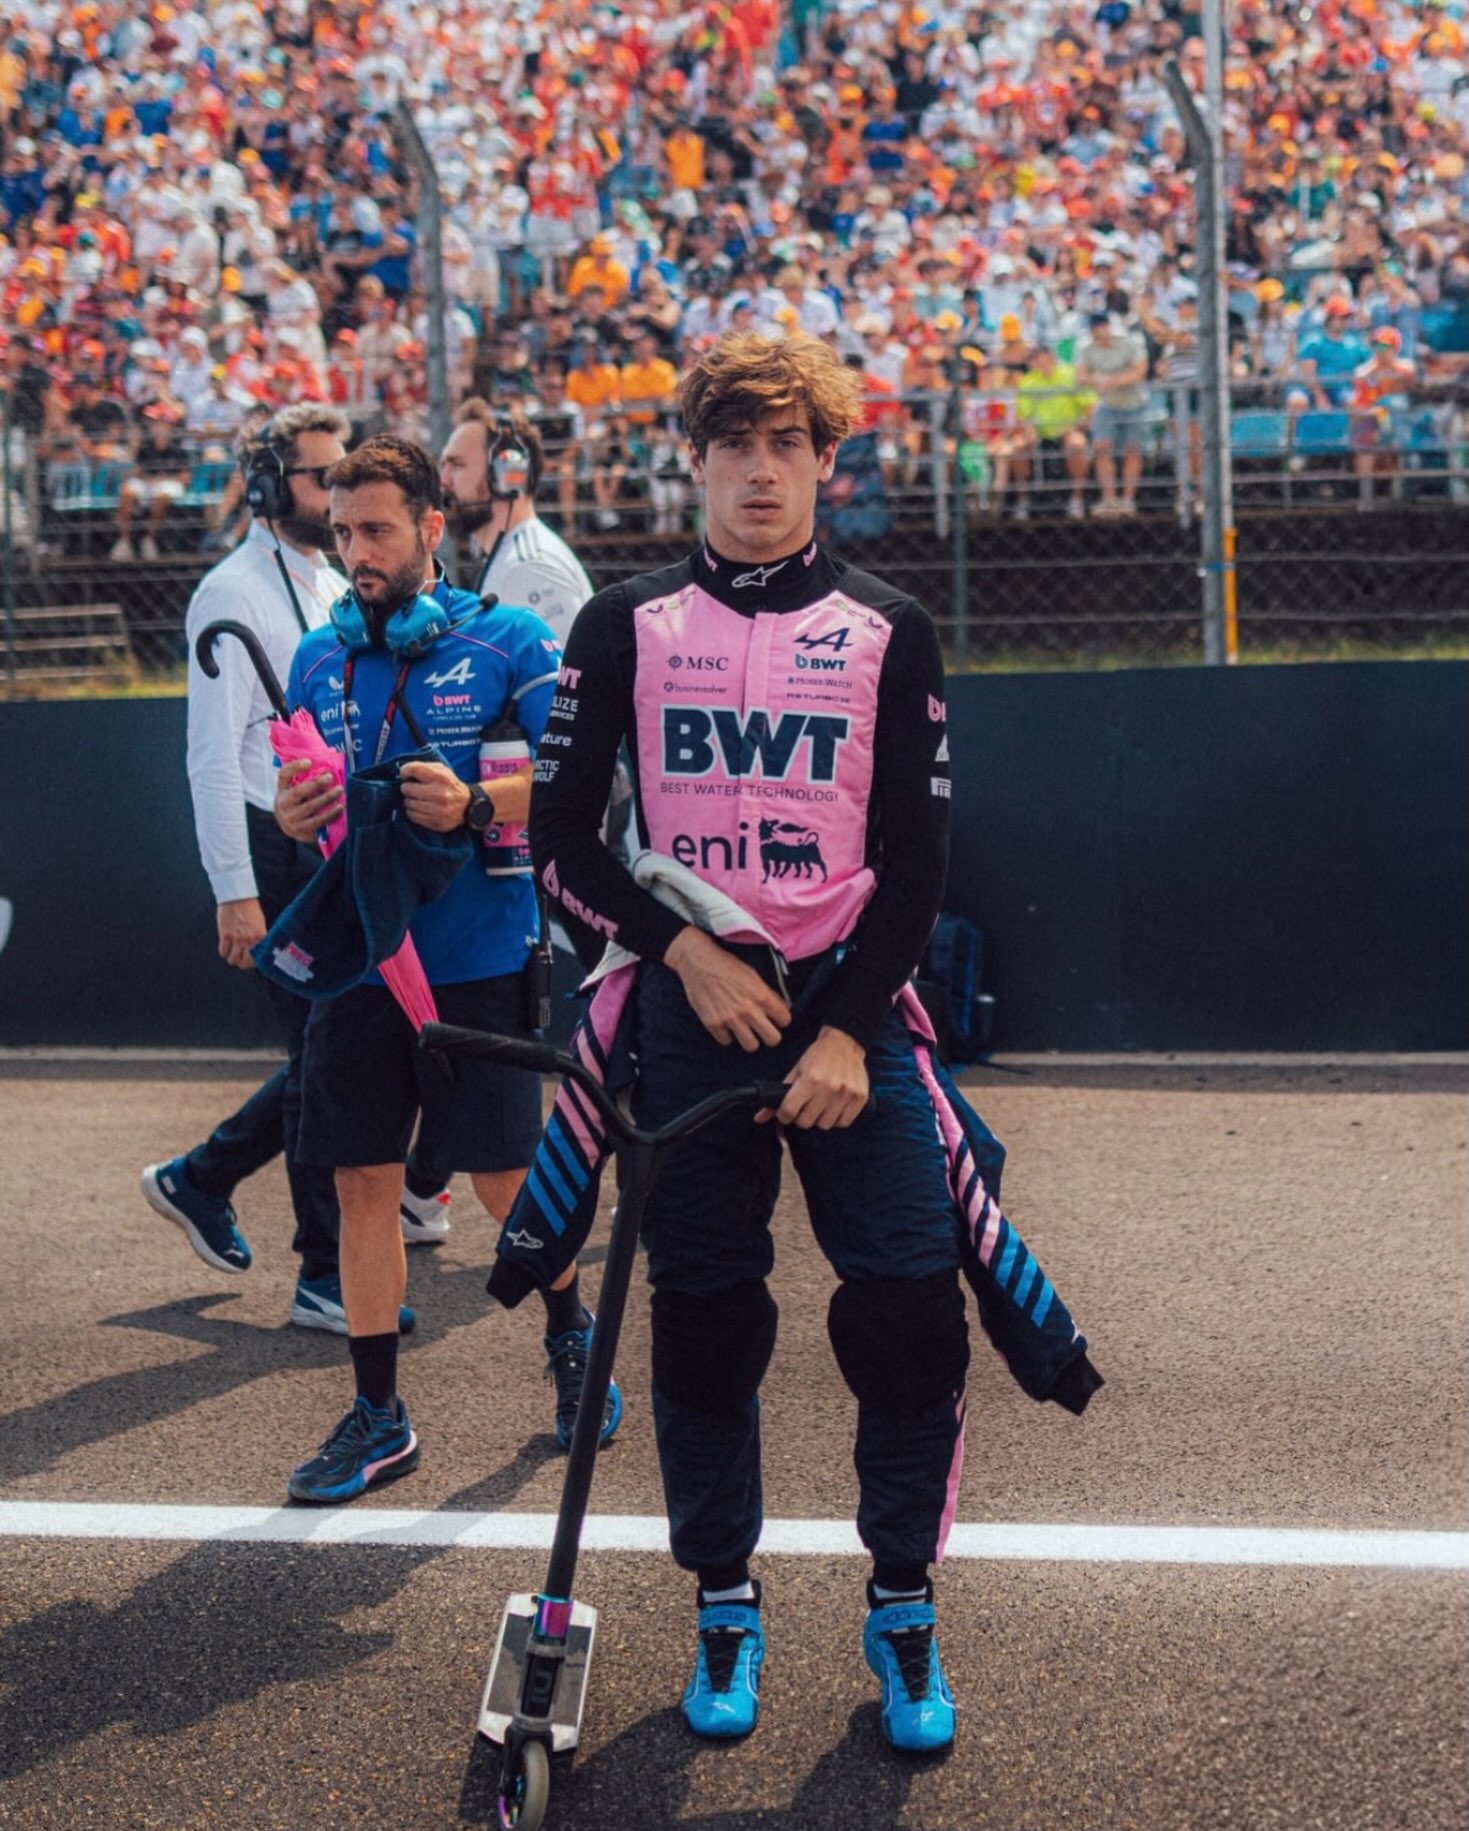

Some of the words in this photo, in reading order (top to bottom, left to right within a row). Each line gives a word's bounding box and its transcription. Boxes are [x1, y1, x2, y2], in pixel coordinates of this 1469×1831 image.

[687, 656, 729, 671] MSC
[810, 658, 847, 671] BWT
[444, 694, 471, 705] BWT
[426, 705, 482, 715] ALPINE
[662, 705, 850, 783] BWT
[660, 782, 690, 794] BEST
[694, 784, 742, 797] WATER
[672, 821, 749, 870] eni
[562, 887, 619, 940] BWT
